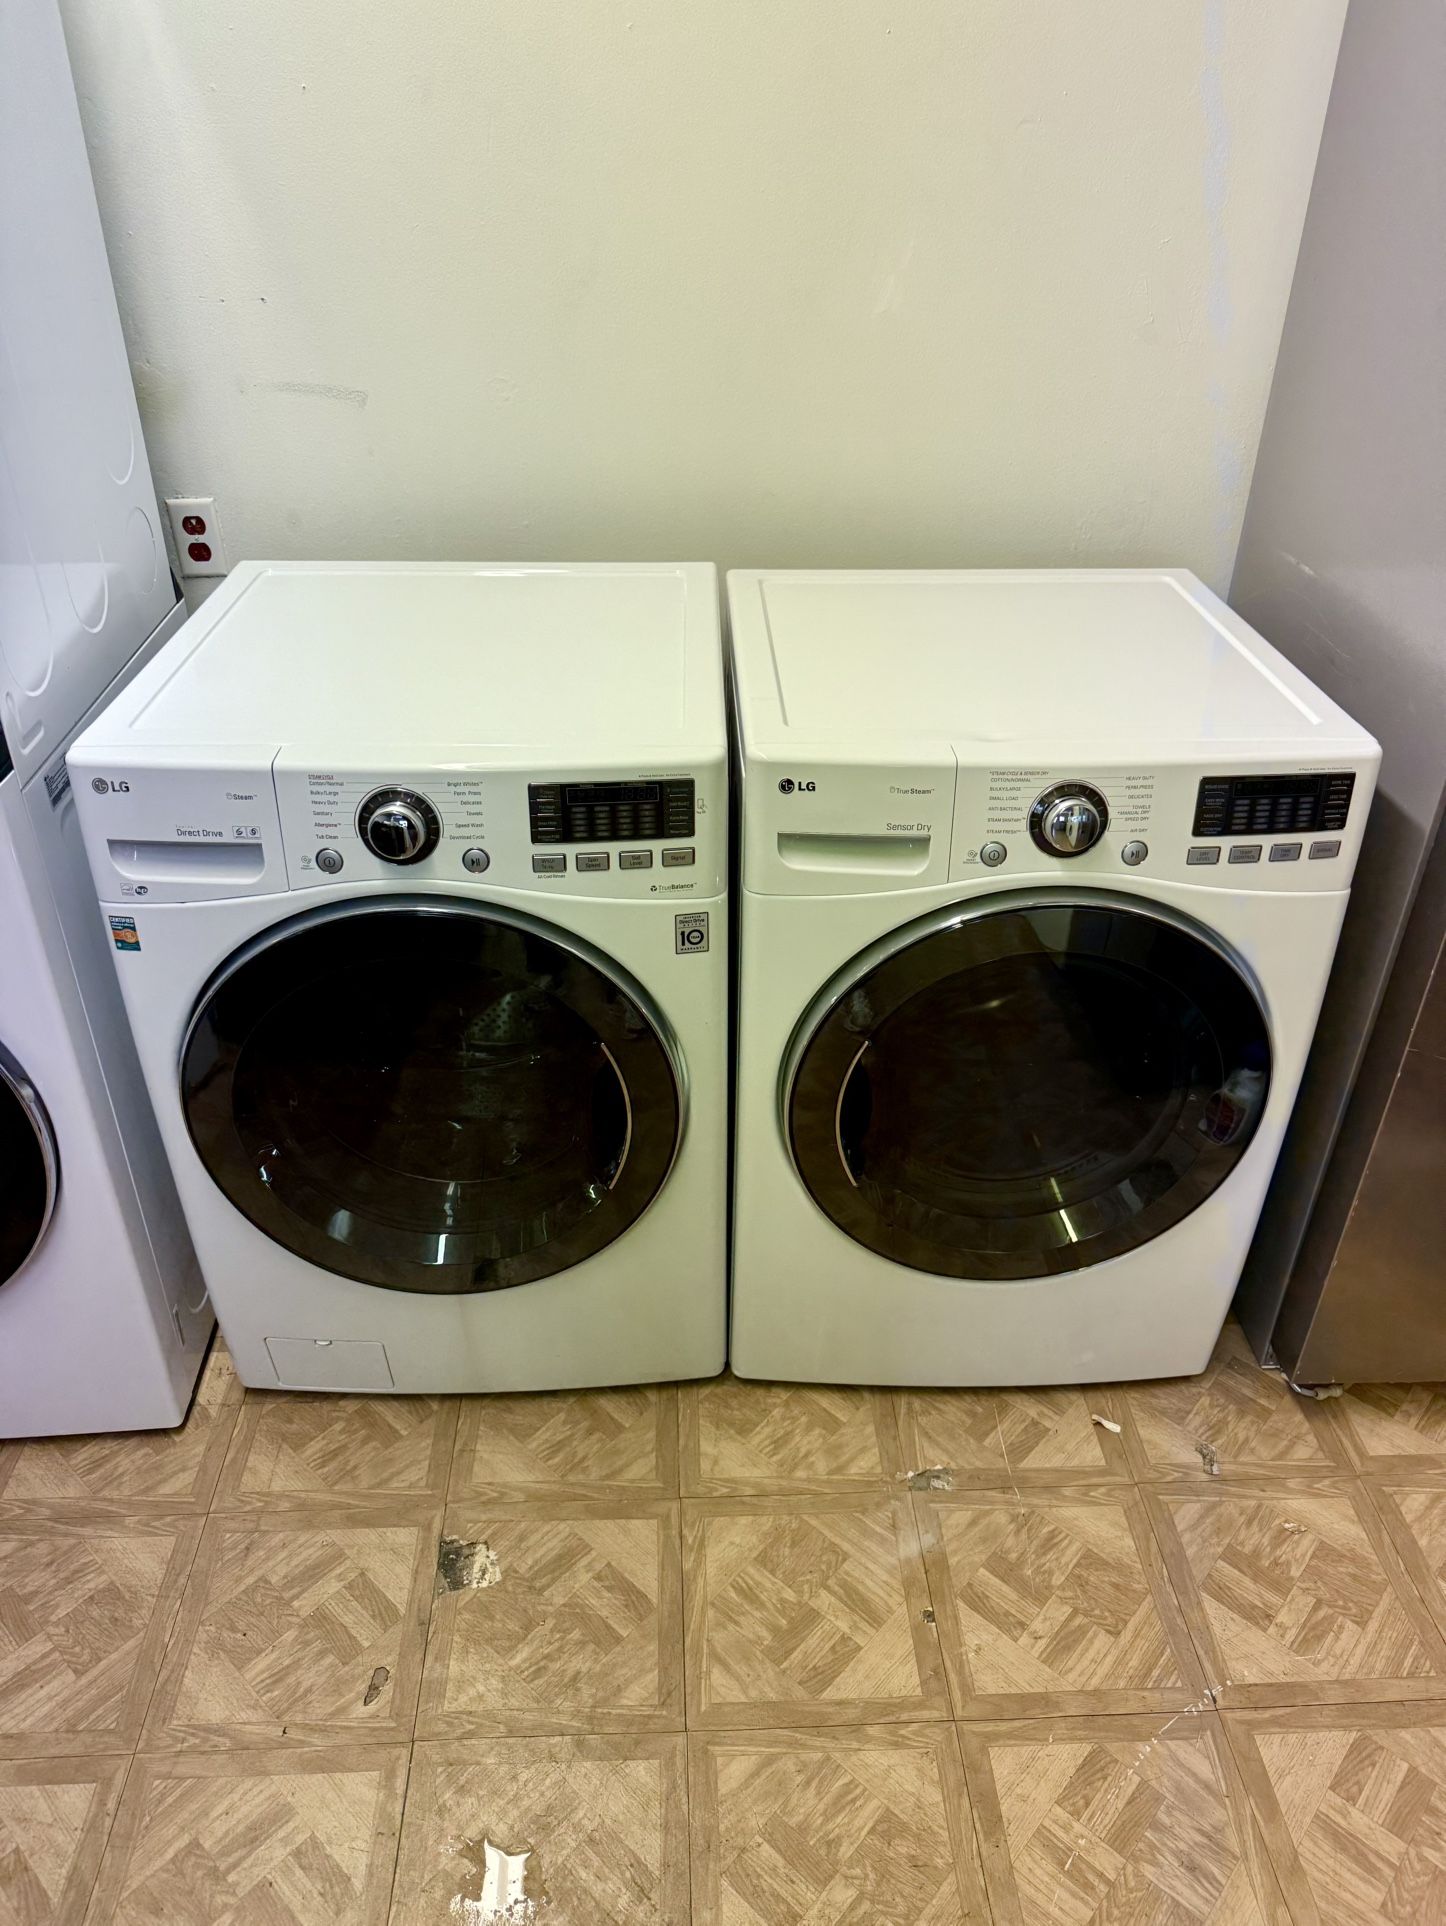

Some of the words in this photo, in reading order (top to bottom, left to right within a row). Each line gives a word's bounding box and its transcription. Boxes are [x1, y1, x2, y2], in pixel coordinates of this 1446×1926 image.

[111, 781, 130, 792] LG
[798, 781, 816, 792] LG
[176, 828, 200, 837] Direct
[202, 830, 223, 838] Drive
[886, 823, 914, 831] Sensor
[917, 823, 931, 832] Dry
[680, 929, 704, 946] 10
